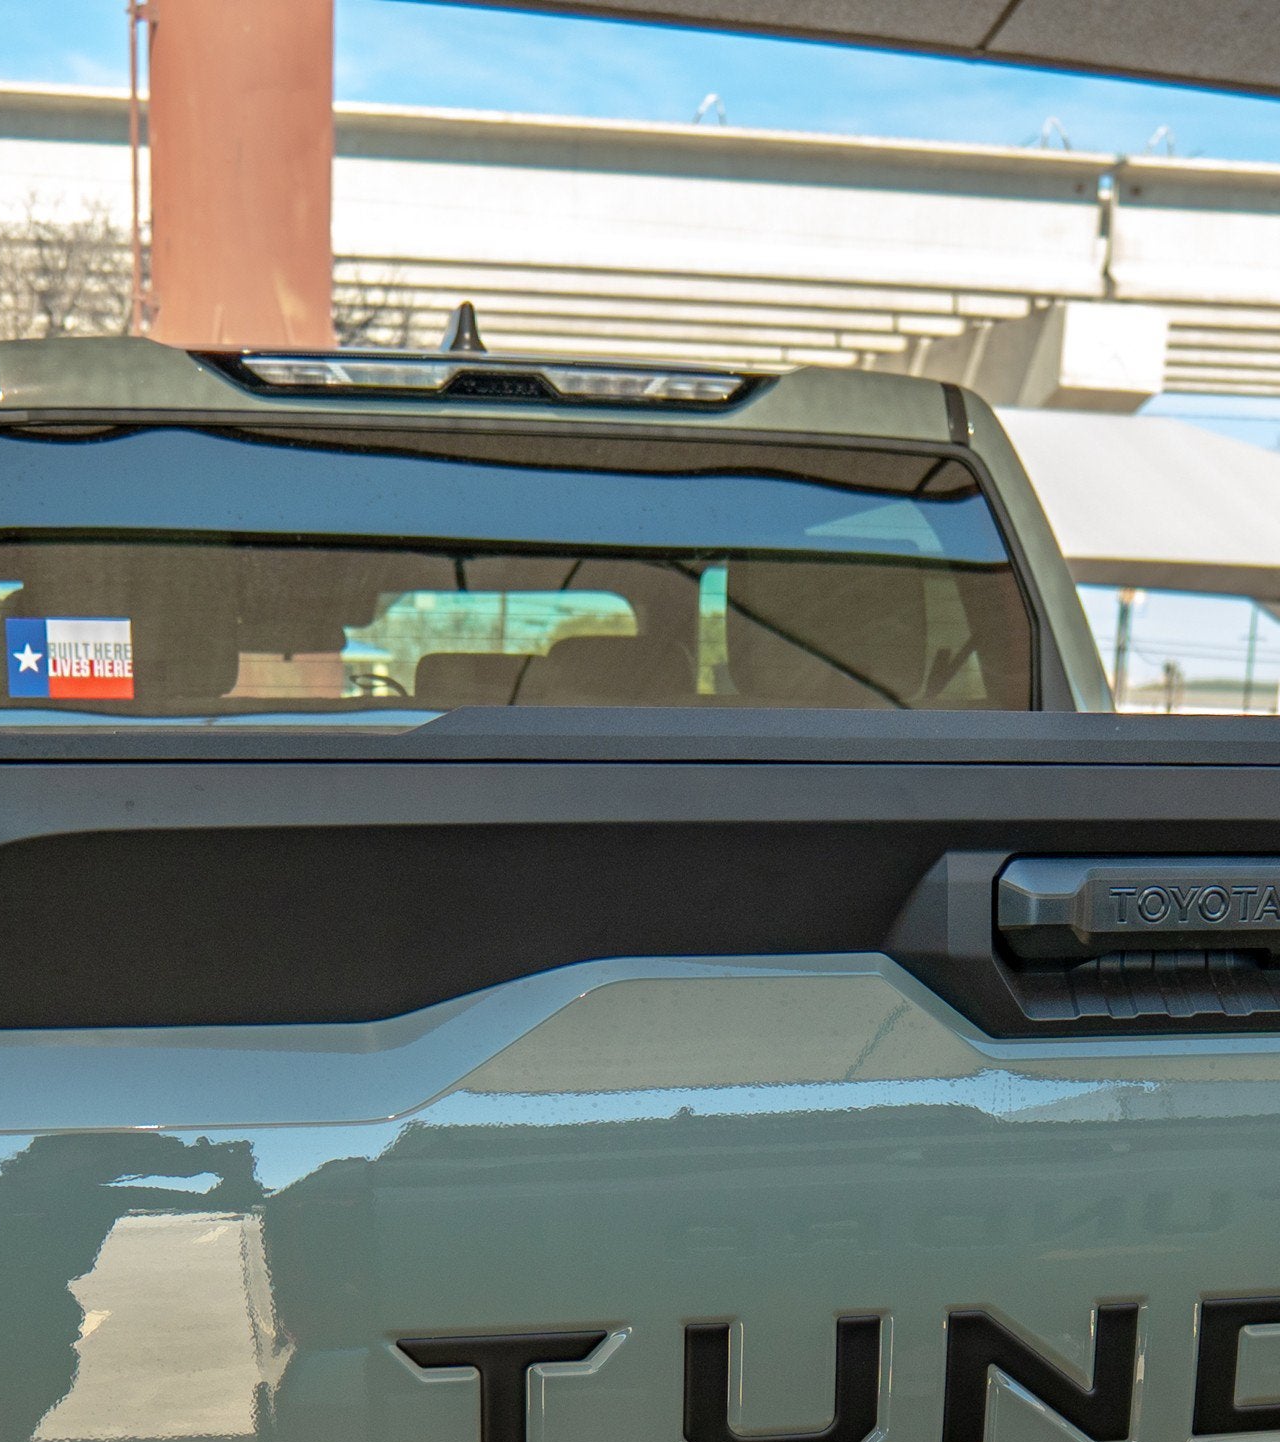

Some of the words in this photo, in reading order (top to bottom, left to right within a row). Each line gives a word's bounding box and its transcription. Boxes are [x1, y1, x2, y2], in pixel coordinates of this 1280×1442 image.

[48, 642, 90, 660] BUILT
[94, 642, 132, 660] HERE
[48, 660, 91, 677] LIVES
[93, 659, 133, 677] HERE
